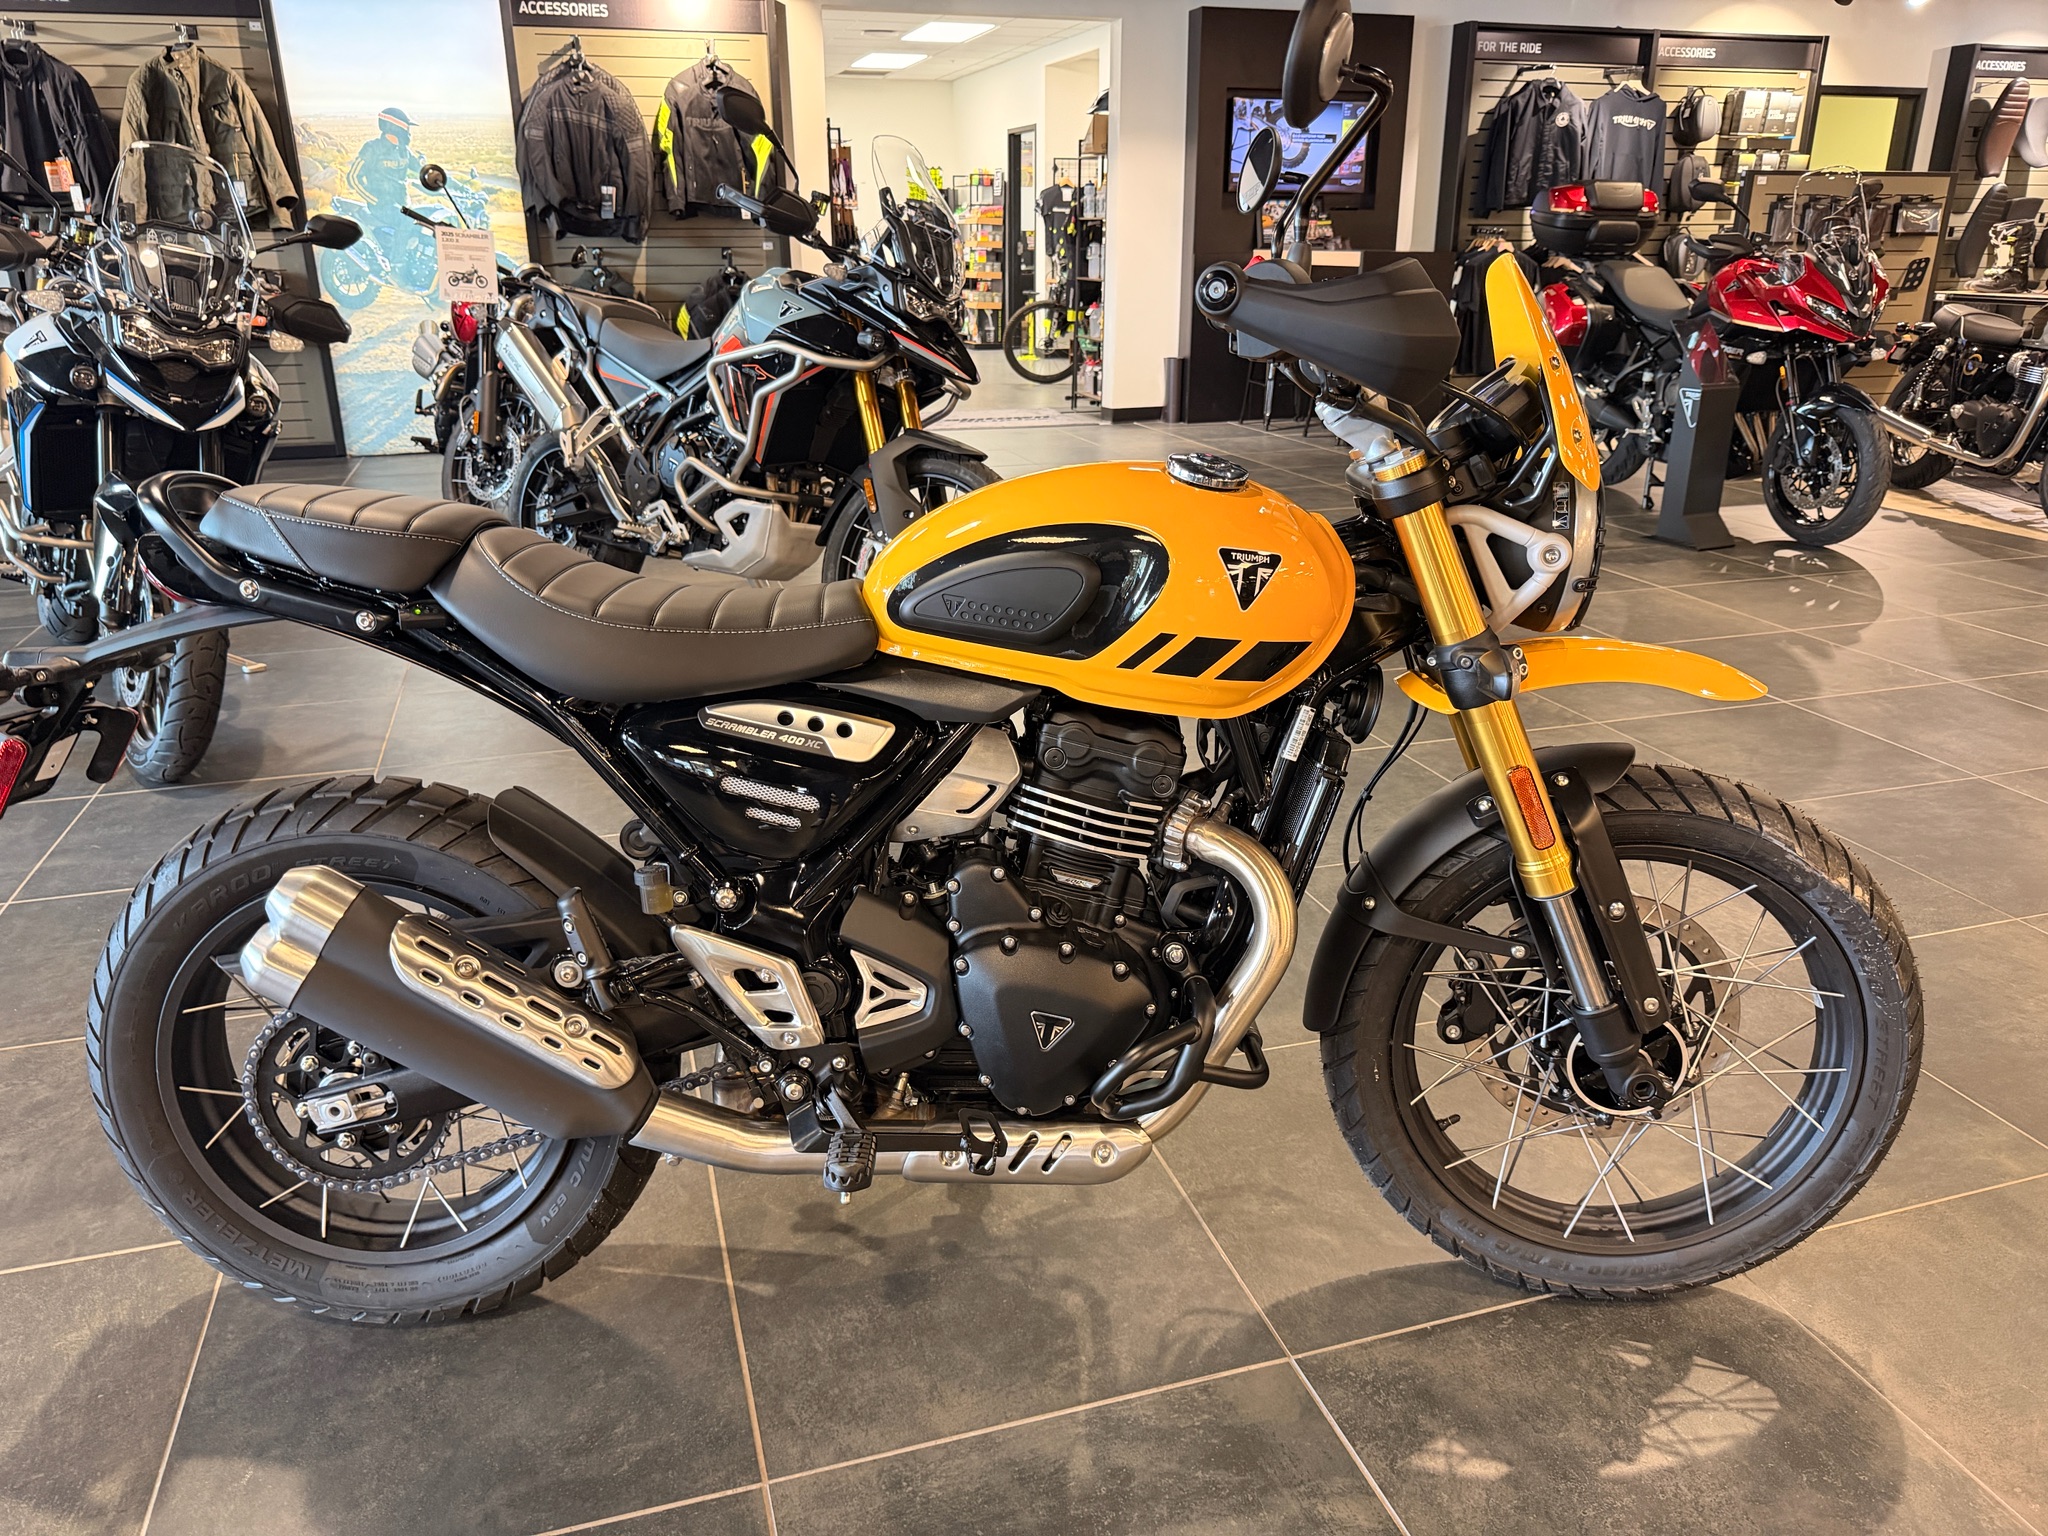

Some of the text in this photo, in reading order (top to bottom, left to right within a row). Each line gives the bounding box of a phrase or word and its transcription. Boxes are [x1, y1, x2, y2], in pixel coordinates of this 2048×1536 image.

[519, 1, 609, 18] ACCESSORIES
[1477, 41, 1542, 54] FOR THE RIDE
[1658, 46, 1717, 59] ACCESSORIES
[1975, 60, 2027, 72] ACCESSORIES
[455, 232, 489, 240] SCRAMBLER
[1231, 552, 1270, 564] TRIUMPH
[705, 717, 824, 749] SCRAMBLER 400 XC
[182, 1188, 313, 1281] METZELER
